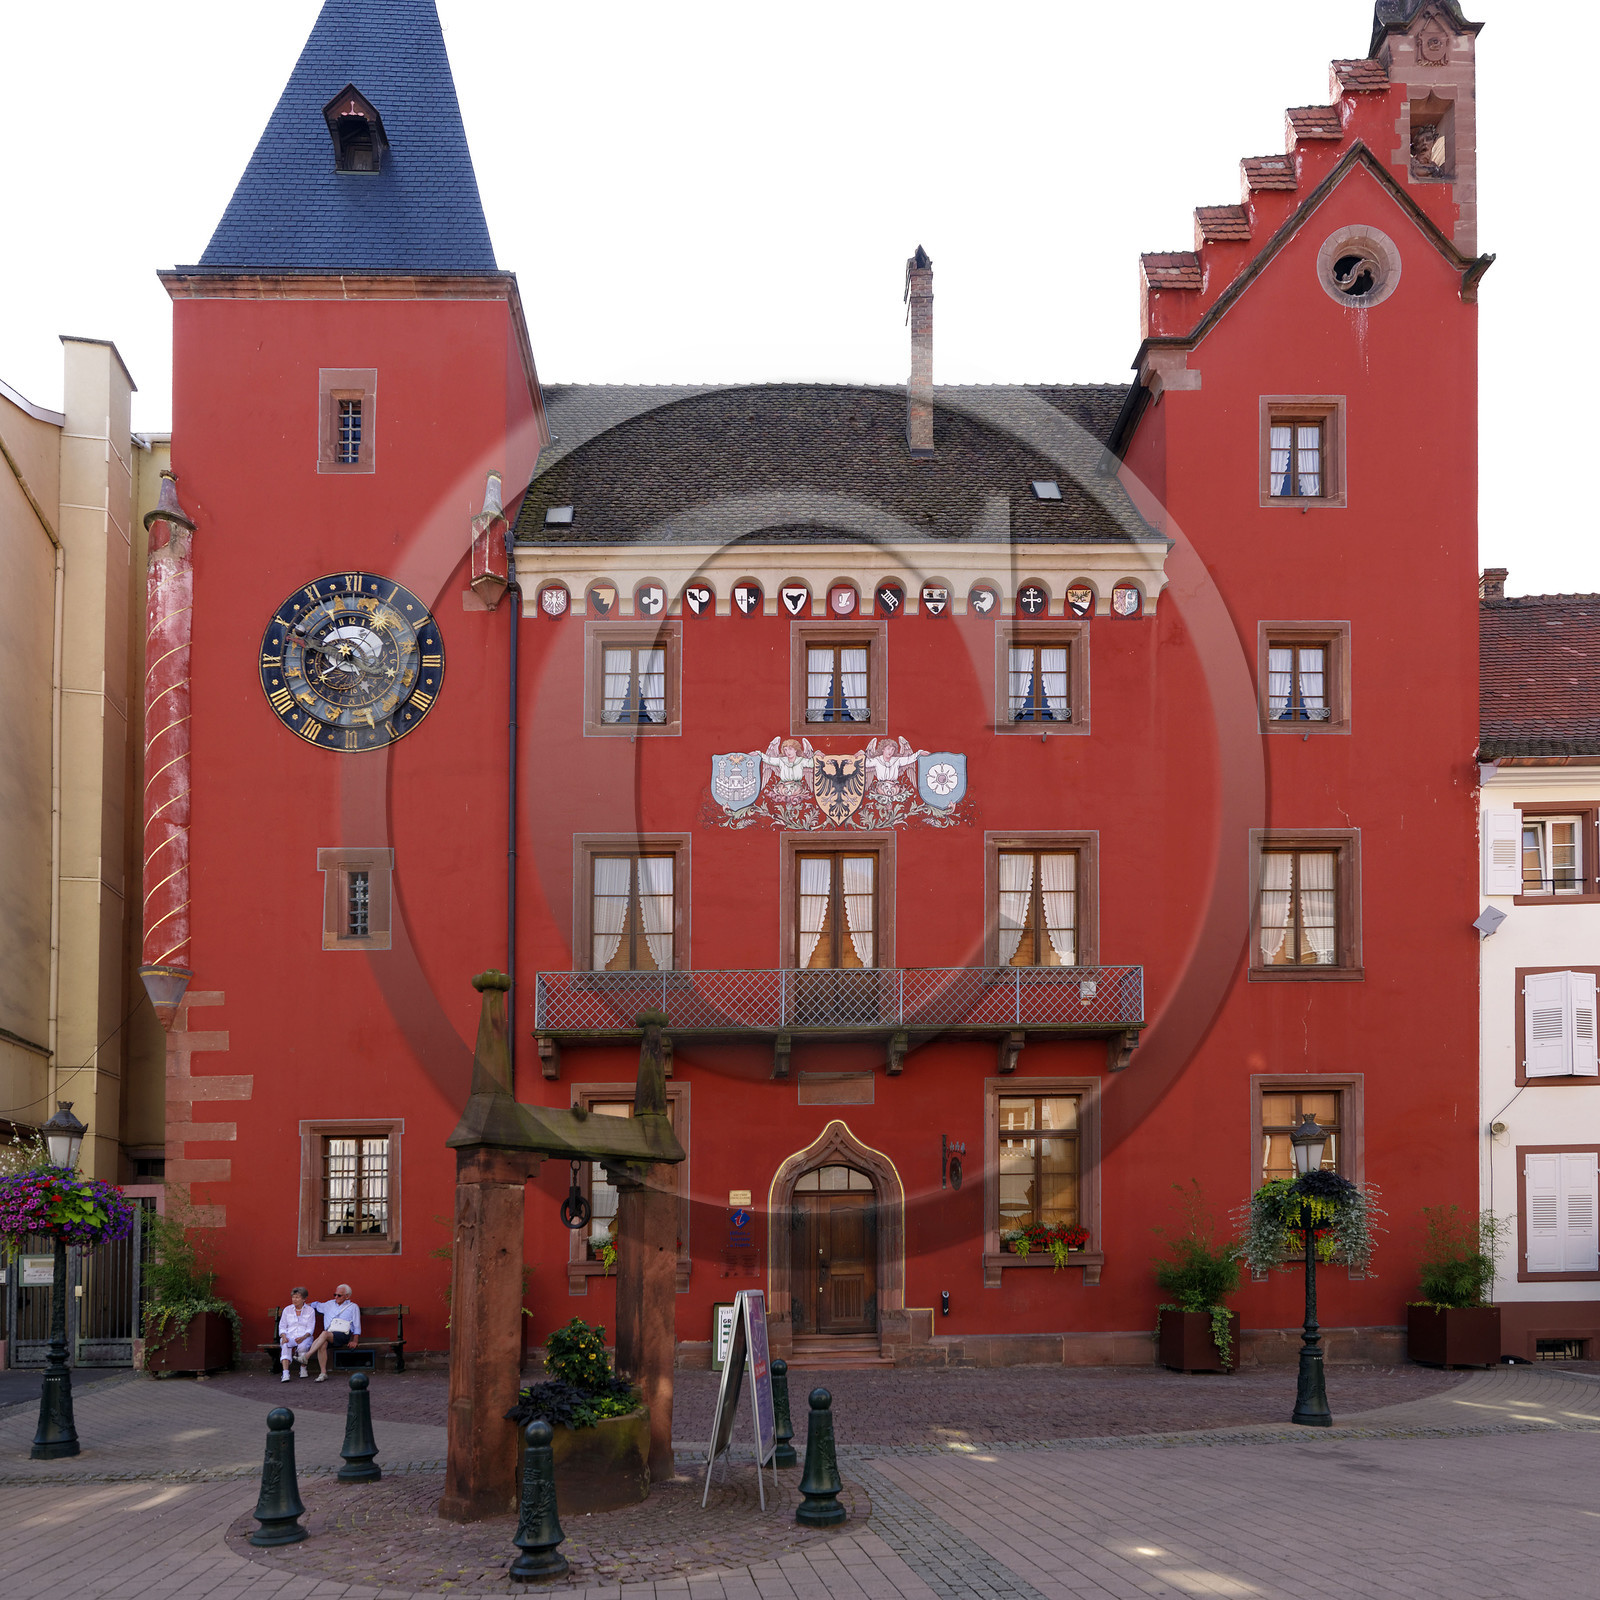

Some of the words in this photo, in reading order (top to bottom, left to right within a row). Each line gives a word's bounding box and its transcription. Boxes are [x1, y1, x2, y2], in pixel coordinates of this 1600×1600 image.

[344, 575, 362, 592] XII
[304, 584, 321, 600] XI
[274, 615, 290, 628] X
[263, 653, 282, 668] IX
